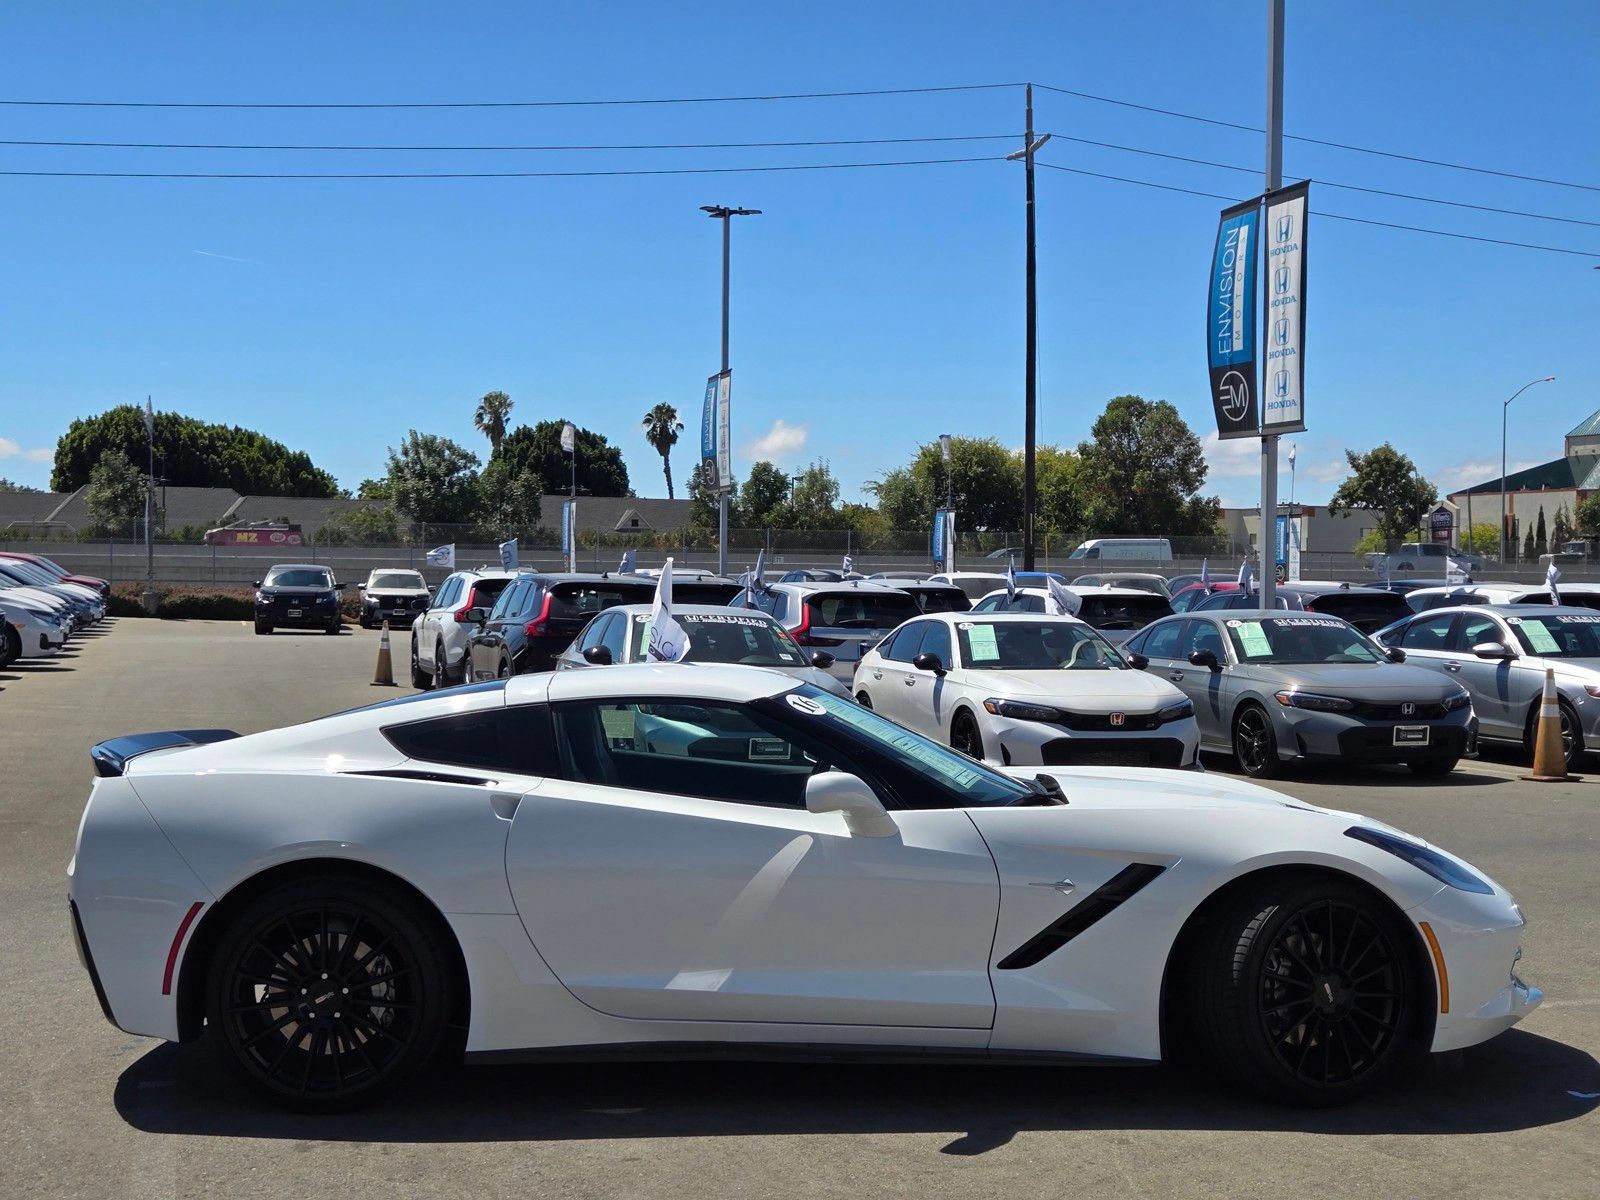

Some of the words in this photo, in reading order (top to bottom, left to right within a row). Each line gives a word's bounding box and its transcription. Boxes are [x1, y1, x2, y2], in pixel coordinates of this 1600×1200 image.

[1270, 243, 1298, 257] HONDA
[1219, 228, 1239, 354] ENVISION
[1235, 236, 1246, 341] MOTORS
[1271, 295, 1297, 308] HONDA
[1269, 347, 1296, 359] HONDA
[1268, 399, 1297, 410] HONDA
[792, 696, 820, 713] 16
